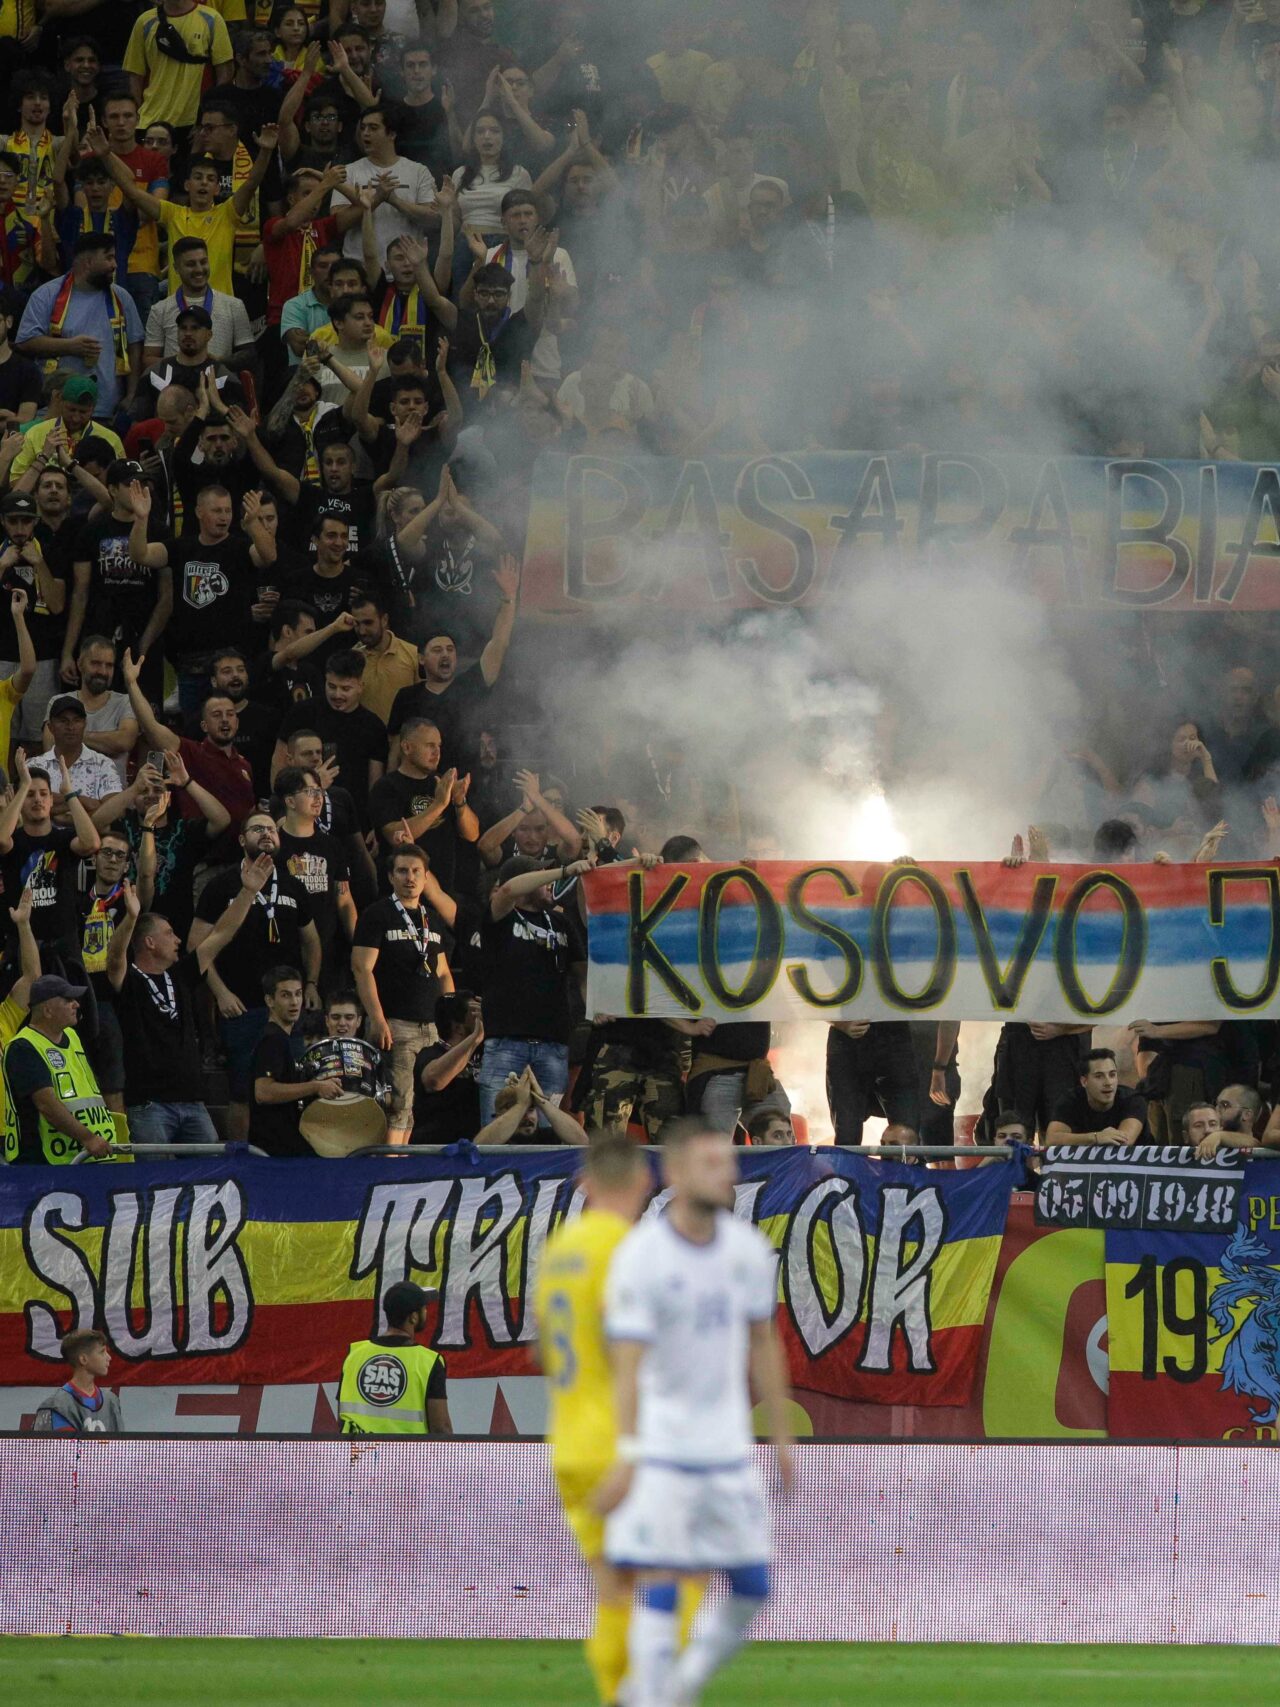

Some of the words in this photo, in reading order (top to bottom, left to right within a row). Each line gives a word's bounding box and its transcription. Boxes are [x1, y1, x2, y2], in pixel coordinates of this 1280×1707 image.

[624, 864, 1150, 1018] KOSOVO
[1037, 1178, 1085, 1219] 05
[1093, 1179, 1140, 1220] 09
[1146, 1181, 1237, 1224] 1948
[23, 1178, 256, 1362] SUB
[350, 1168, 949, 1375] TRIOR
[1125, 1254, 1209, 1384] 19
[363, 1364, 402, 1387] SAS
[363, 1383, 400, 1396] TEAM
